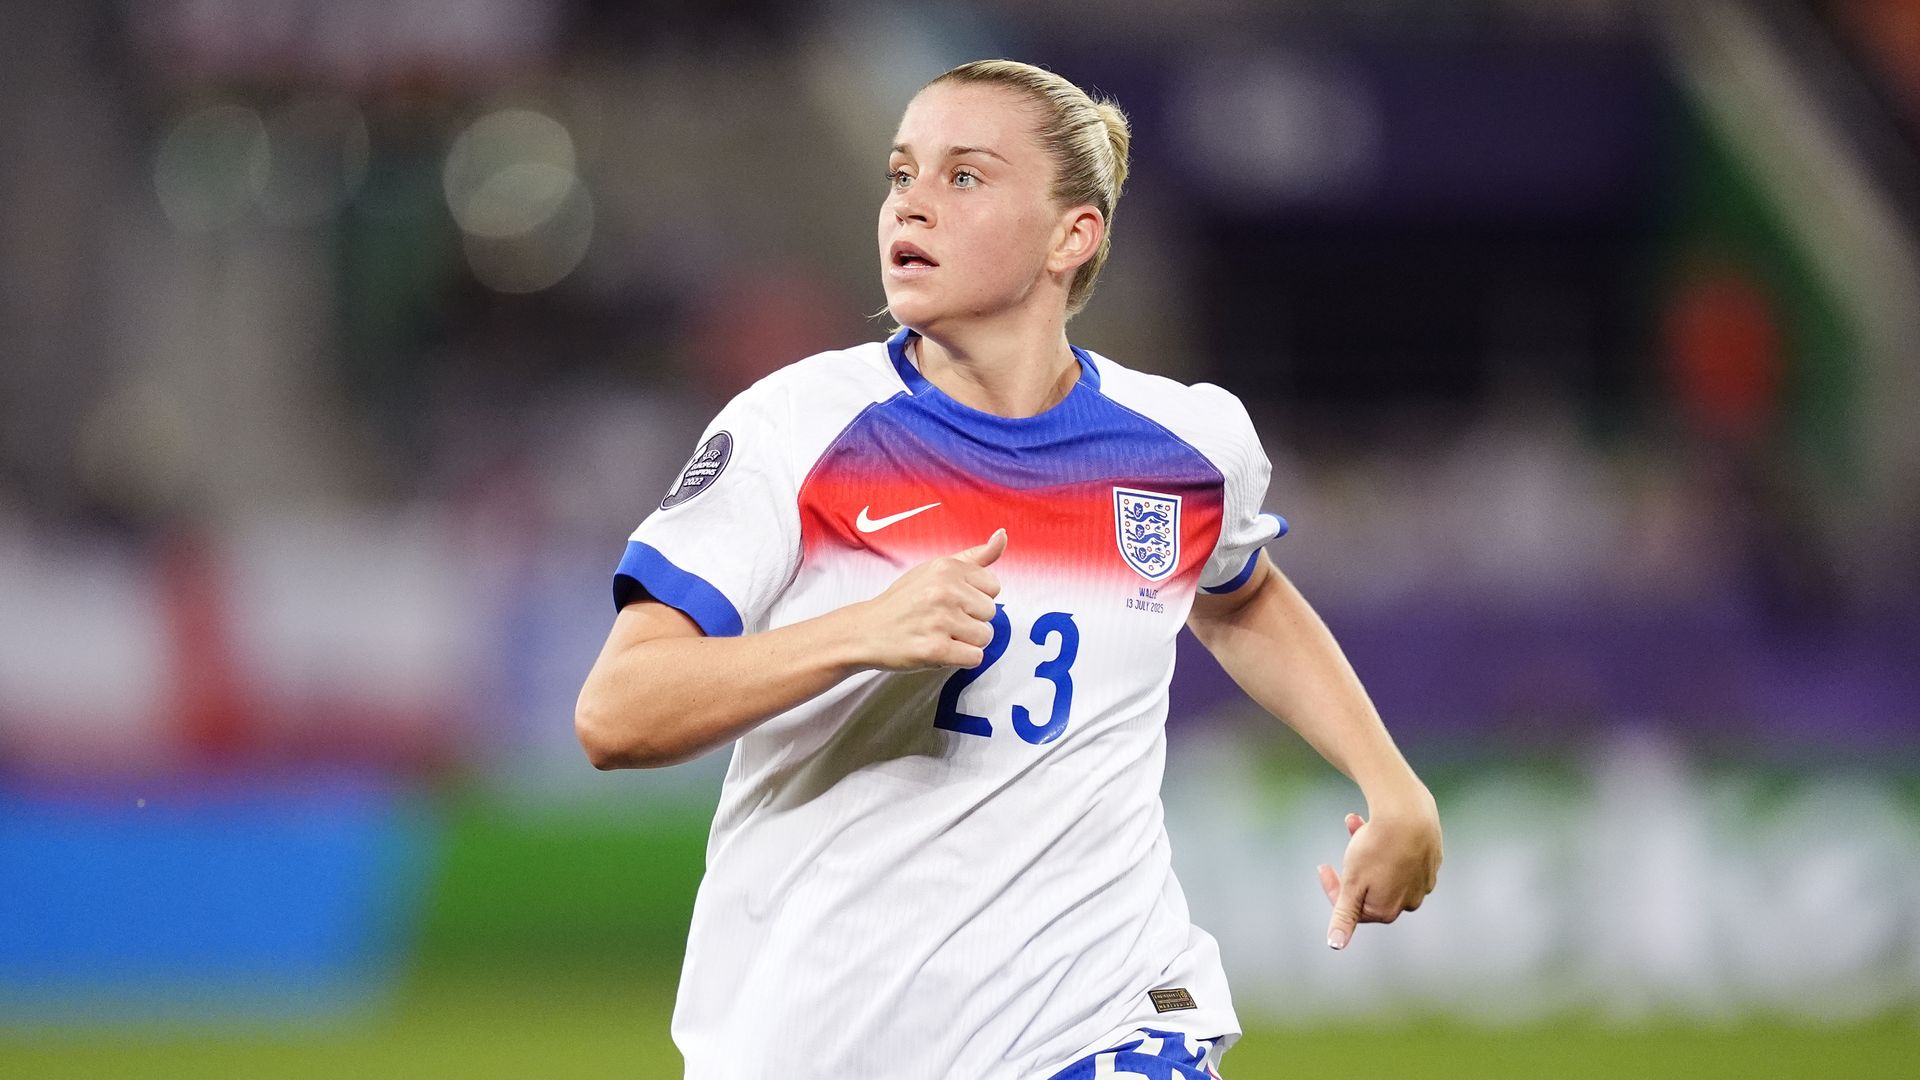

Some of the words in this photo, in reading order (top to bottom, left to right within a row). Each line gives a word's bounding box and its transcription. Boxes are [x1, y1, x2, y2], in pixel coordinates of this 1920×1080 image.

[691, 461, 721, 470] EUROPEAN
[685, 469, 717, 478] CHAMPIONS
[683, 477, 704, 487] 2022
[1126, 598, 1133, 609] 13
[1134, 599, 1150, 611] JULY
[1150, 602, 1164, 614] 2025
[933, 603, 1080, 745] 23
